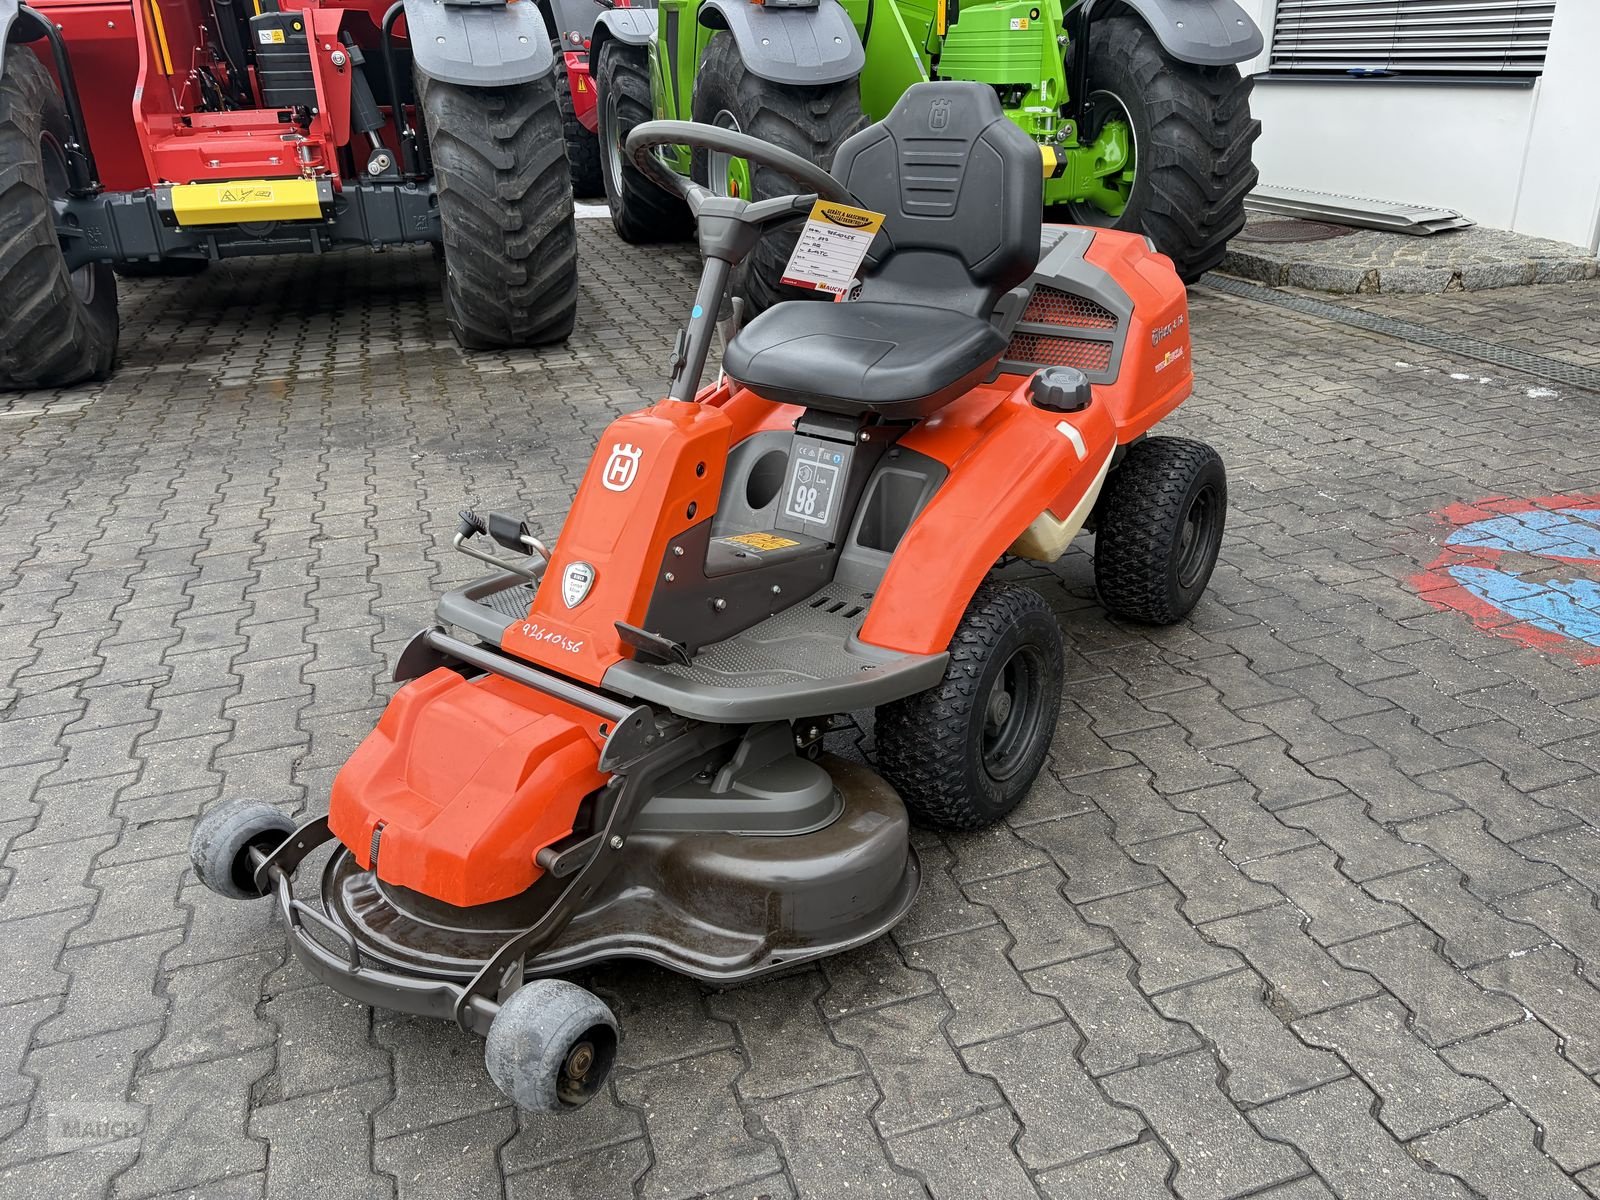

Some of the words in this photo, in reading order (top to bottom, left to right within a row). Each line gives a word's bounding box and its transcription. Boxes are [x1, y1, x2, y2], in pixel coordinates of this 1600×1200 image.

[820, 283, 843, 293] MAUCH
[794, 485, 818, 515] 98
[522, 623, 584, 653] 92610456
